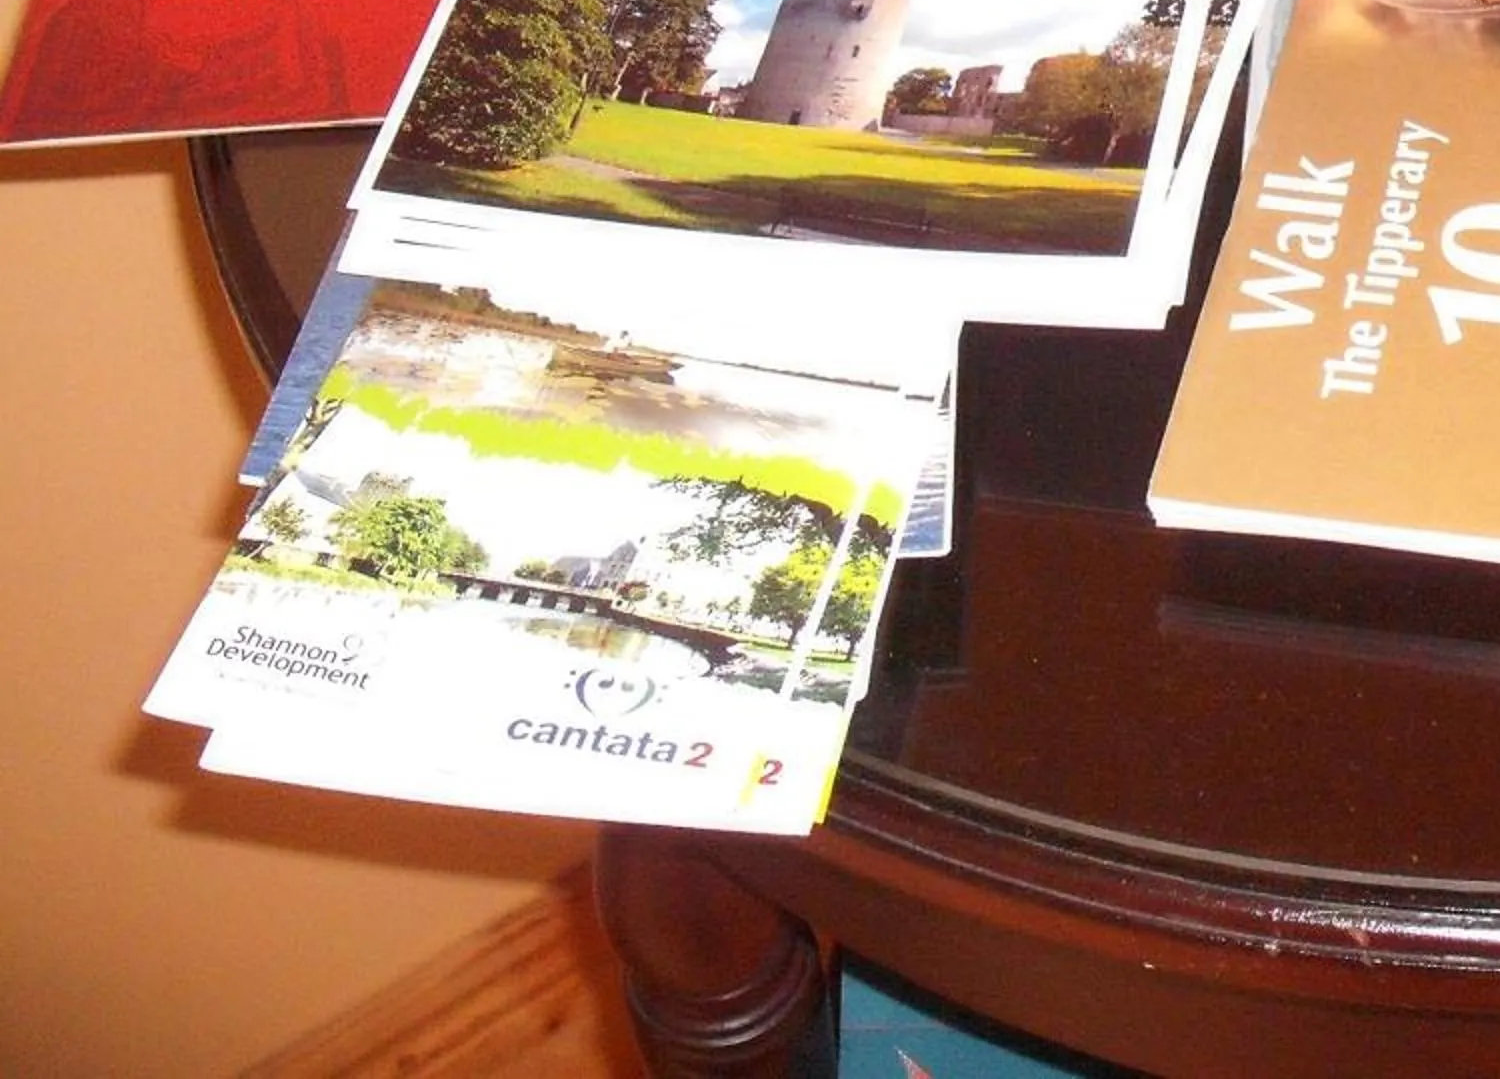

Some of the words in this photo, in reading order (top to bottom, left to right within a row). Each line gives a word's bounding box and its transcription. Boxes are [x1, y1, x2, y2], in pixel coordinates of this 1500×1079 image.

[1345, 120, 1450, 307] Tipperary
[1228, 155, 1355, 331] Walk
[1320, 320, 1387, 399] The
[206, 638, 371, 690] Development
[233, 625, 338, 664] Shannon
[683, 741, 714, 768] 2
[758, 758, 783, 785] 2
